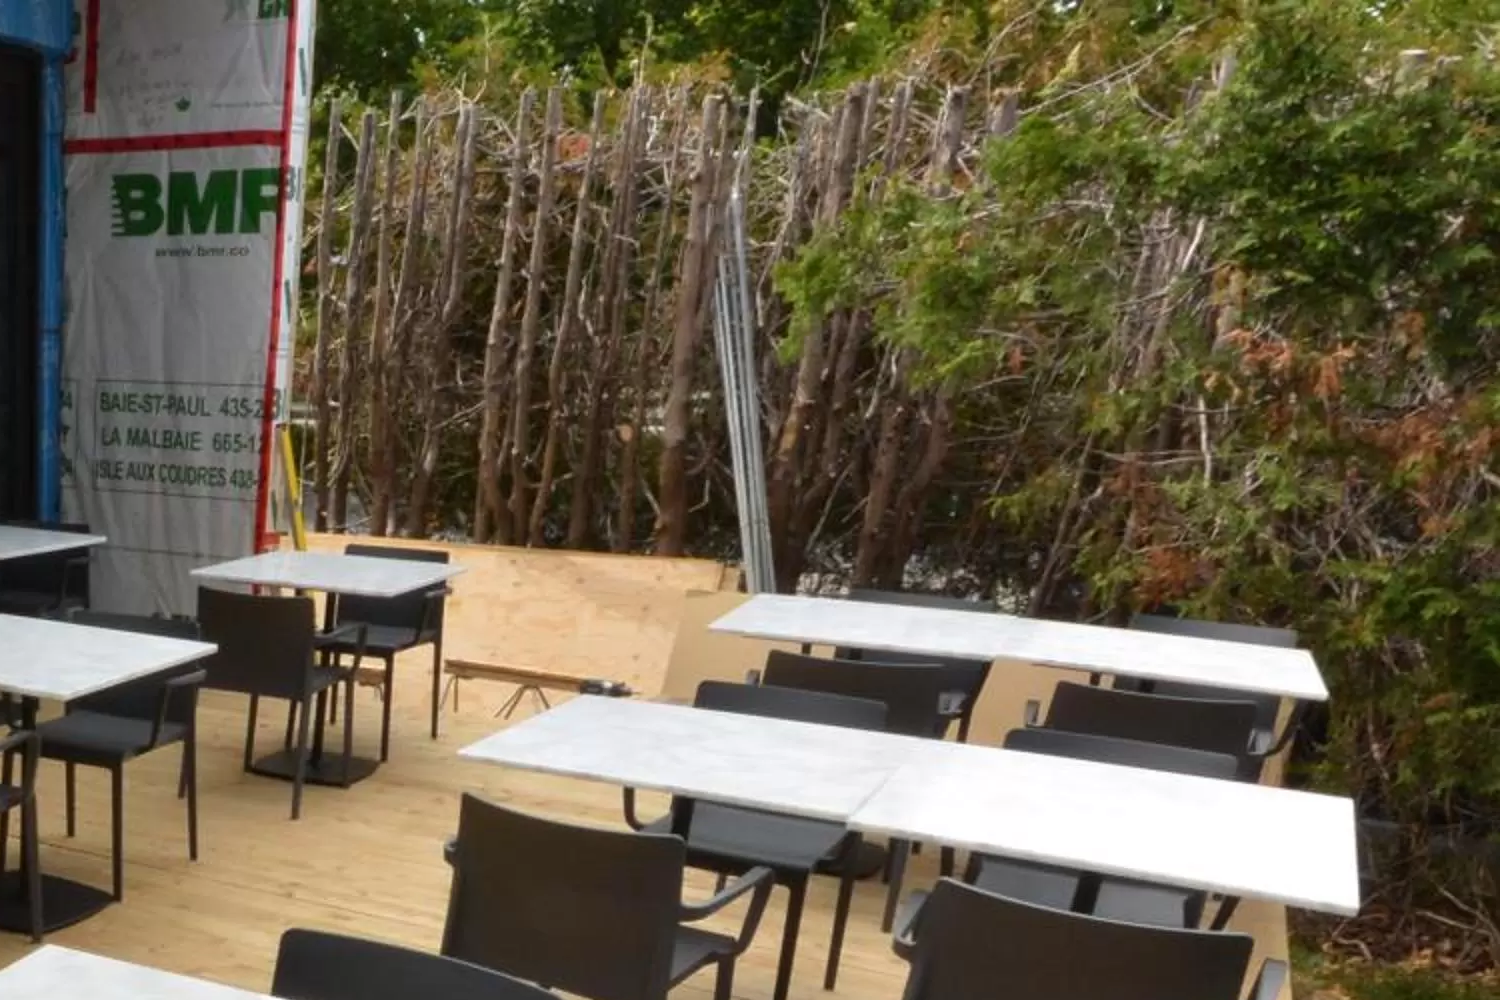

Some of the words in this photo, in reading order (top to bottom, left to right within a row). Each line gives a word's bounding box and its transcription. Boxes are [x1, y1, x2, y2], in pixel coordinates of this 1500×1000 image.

[100, 391, 211, 417] BAIE-ST-PAUL
[219, 396, 268, 418] 435-2
[102, 427, 122, 446] LA
[126, 428, 203, 452] MALBAIE
[126, 462, 156, 480] AUX
[158, 464, 226, 486] COUDRES
